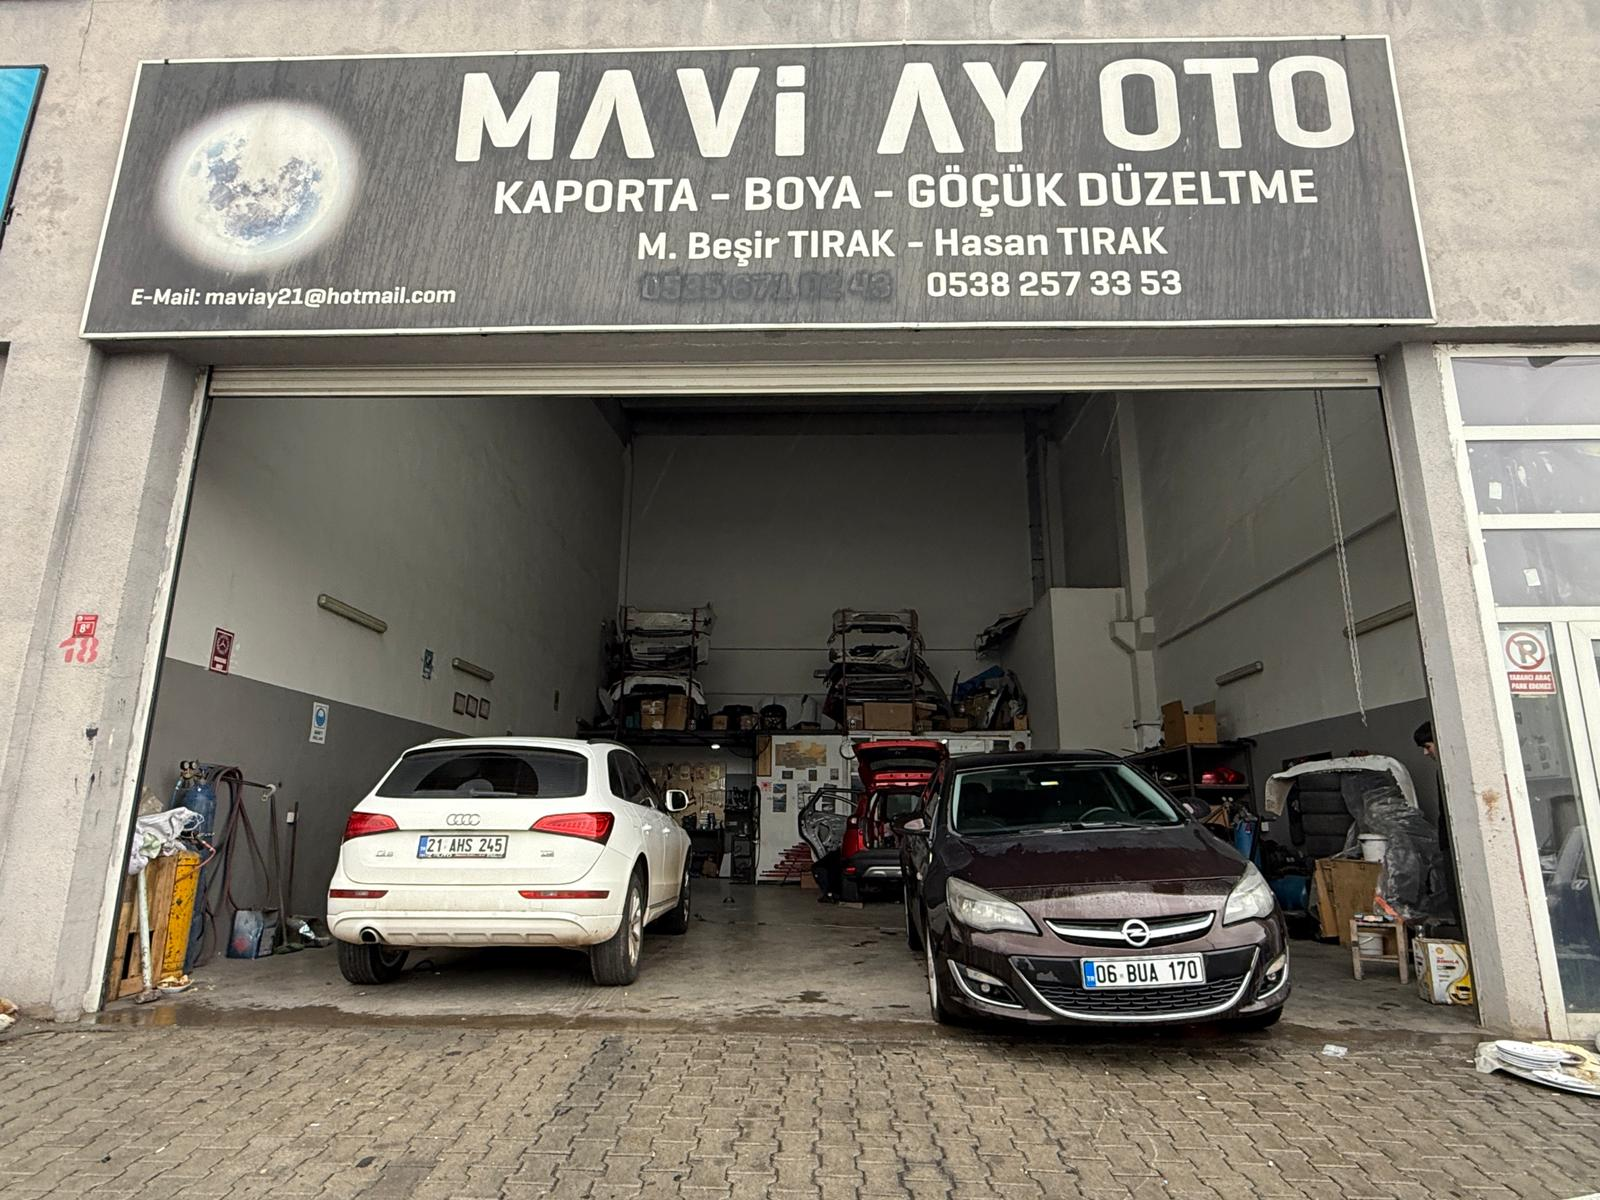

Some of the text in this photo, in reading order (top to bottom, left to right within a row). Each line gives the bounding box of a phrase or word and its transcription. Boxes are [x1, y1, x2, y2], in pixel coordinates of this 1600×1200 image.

[877, 60, 1048, 154] AY
[1099, 55, 1355, 152] OTO
[493, 177, 699, 215] KAPORTA
[744, 175, 862, 211] BOYA
[908, 164, 1067, 218] GÖÇÜK
[1079, 163, 1319, 207] DÜZELTME
[637, 231, 677, 260] M.
[688, 230, 781, 267] Beşir
[787, 228, 896, 259] TIRAK
[934, 228, 1049, 257] Hasan
[1056, 226, 1169, 256] TIRAK
[131, 285, 457, 310] E-Mail: maviay21@hotmail.com
[927, 269, 1183, 298] 0538 257 33 53
[427, 838, 442, 852] 21
[449, 838, 473, 852] AHS
[479, 838, 502, 852] 245
[1096, 964, 1117, 983] 06
[1127, 963, 1159, 983] BUA
[1169, 960, 1198, 981] 170
